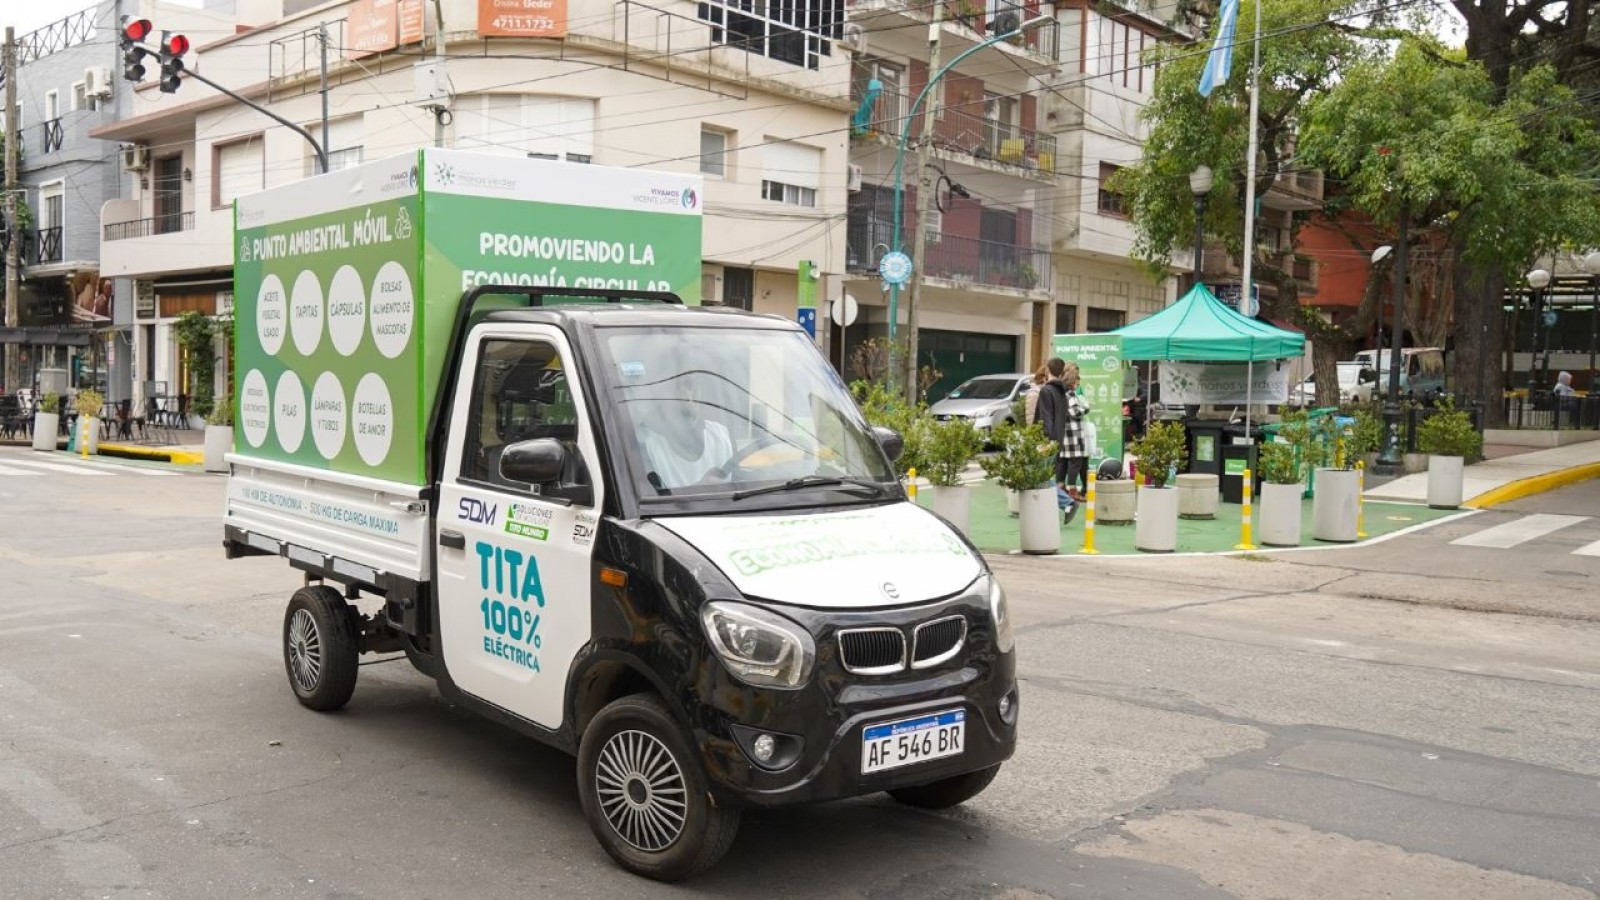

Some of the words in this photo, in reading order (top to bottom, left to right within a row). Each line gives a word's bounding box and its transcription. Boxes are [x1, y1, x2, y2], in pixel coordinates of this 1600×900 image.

[492, 19, 554, 29] 4711.1732
[633, 194, 657, 204] VICENTE
[650, 188, 680, 198] VIVAMOS
[253, 234, 286, 261] PUNTO
[289, 222, 350, 256] AMBIENTAL
[352, 209, 393, 247] MÓVIL
[479, 232, 625, 265] PROMOVIENDO
[629, 243, 656, 266] LA
[380, 280, 403, 294] BOLSAS
[295, 305, 319, 319] TAPITAS
[330, 301, 364, 317] CÁPSULAS
[372, 302, 402, 315] ALIMENTO
[402, 301, 411, 314] DE
[376, 323, 408, 336] MASCOTAS
[1056, 345, 1080, 353] PUNTO
[1080, 344, 1120, 352] AMBIENTAL
[1199, 380, 1235, 391] manos
[281, 404, 298, 417] PILAS
[357, 401, 387, 416] BOTELLAS
[317, 419, 323, 430] Y
[323, 419, 340, 432] TUBOS
[358, 422, 367, 435] DE
[367, 423, 387, 436] AMOR
[260, 490, 269, 502] DE
[323, 506, 333, 519] KG
[333, 508, 343, 521] DE
[343, 509, 368, 527] CARGA
[369, 516, 400, 535] MAXIMA
[458, 497, 497, 526] SDM
[573, 524, 594, 538] SDM
[475, 541, 545, 608] TITA
[480, 597, 542, 649] 100%
[483, 635, 541, 673] ELÉCTRICA
[868, 739, 892, 767] AF
[898, 731, 932, 761] 546
[938, 725, 960, 753] BR
